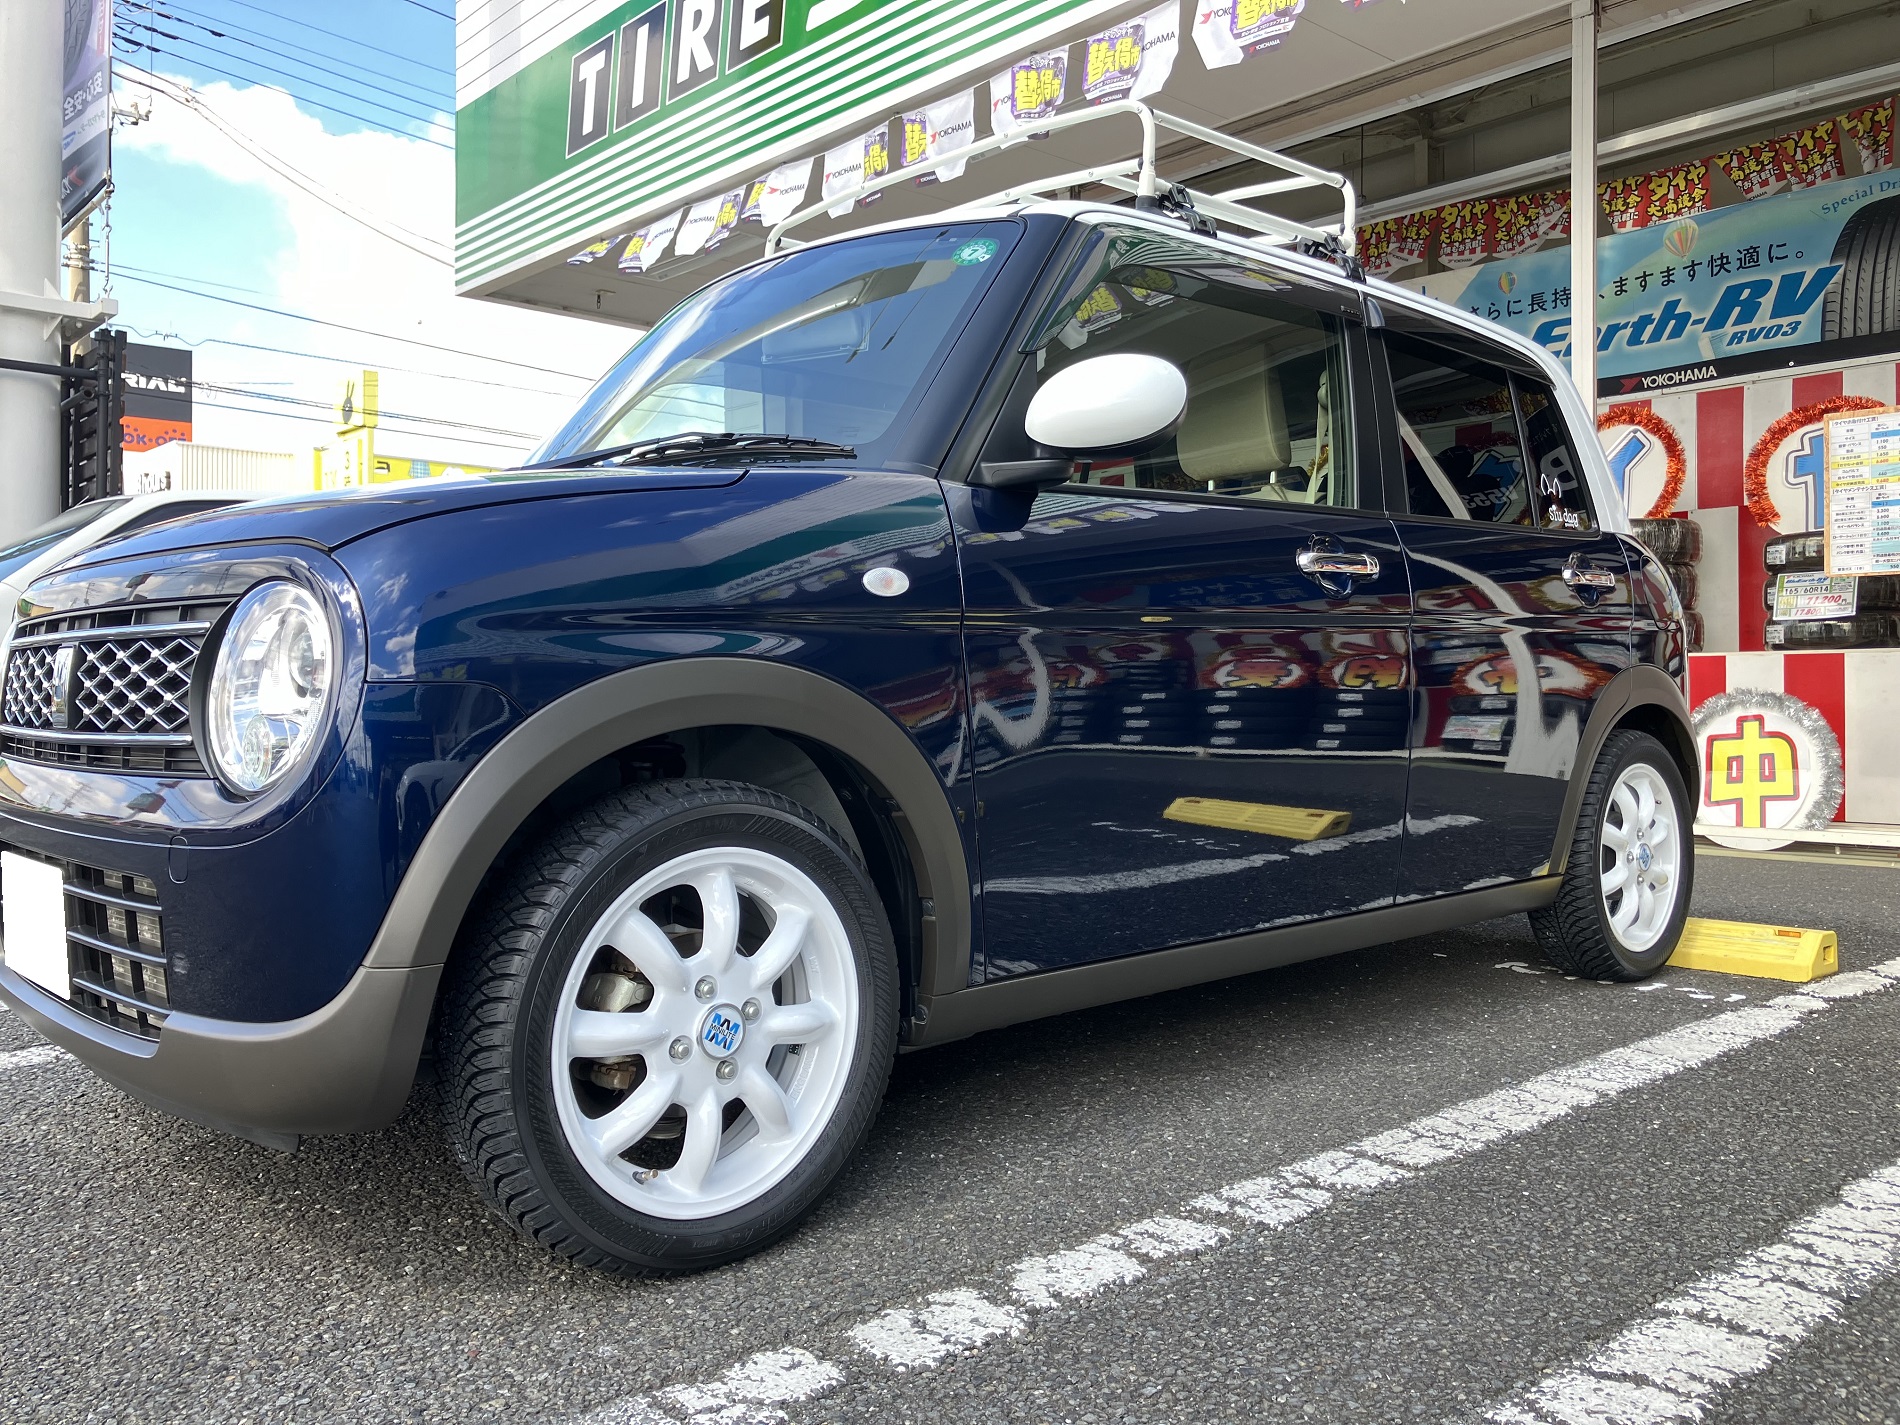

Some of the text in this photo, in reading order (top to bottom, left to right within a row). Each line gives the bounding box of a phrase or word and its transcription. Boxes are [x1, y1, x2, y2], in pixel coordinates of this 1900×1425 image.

[1256, 39, 1280, 50] YOKOHAMA
[936, 120, 973, 139] YOKOHAMA
[831, 162, 862, 179] YOKOHAMA
[779, 184, 805, 196] YOKOHAMA
[1648, 165, 1706, 202] タイヤ
[1647, 187, 1707, 217] 大商談会
[1821, 185, 1874, 214] Special
[1440, 201, 1489, 229] タイヤ
[1726, 320, 1802, 347] RV03
[1641, 365, 1718, 389] YOKOHAMA
[1563, 508, 1578, 527] dog
[1785, 586, 1829, 595] 165/60R14
[1705, 714, 1799, 827] 中
[709, 1023, 737, 1041] MINILITE
